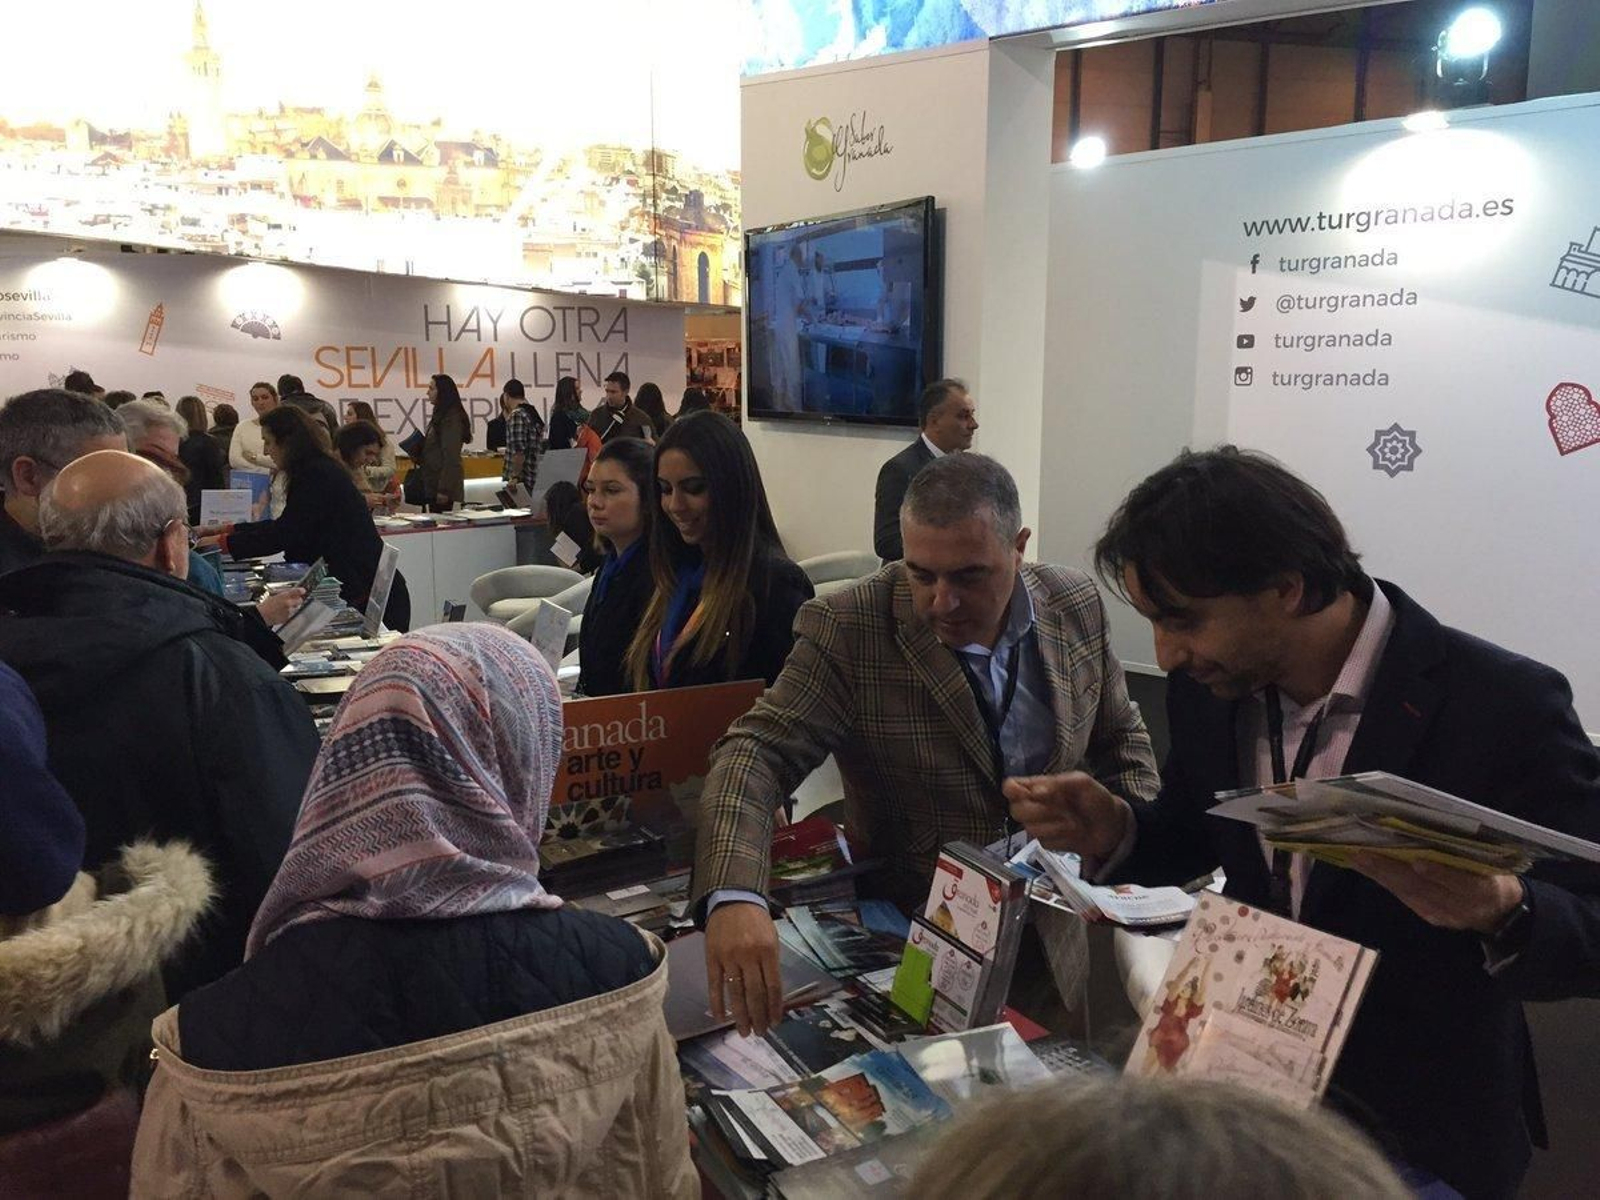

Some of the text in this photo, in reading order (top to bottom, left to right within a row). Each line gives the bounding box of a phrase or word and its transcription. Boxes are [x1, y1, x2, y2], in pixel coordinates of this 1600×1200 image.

[1243, 198, 1514, 237] www.turgranada.es
[1278, 248, 1398, 275] turgranada
[1276, 288, 1418, 314] @turgranada
[424, 304, 628, 343] HAY OTRA
[1274, 329, 1393, 352] turgranada
[314, 345, 629, 389] SEVILLA LLENA
[1271, 369, 1389, 390] turgranada
[567, 747, 644, 775] arte y
[567, 770, 662, 802] cultura
